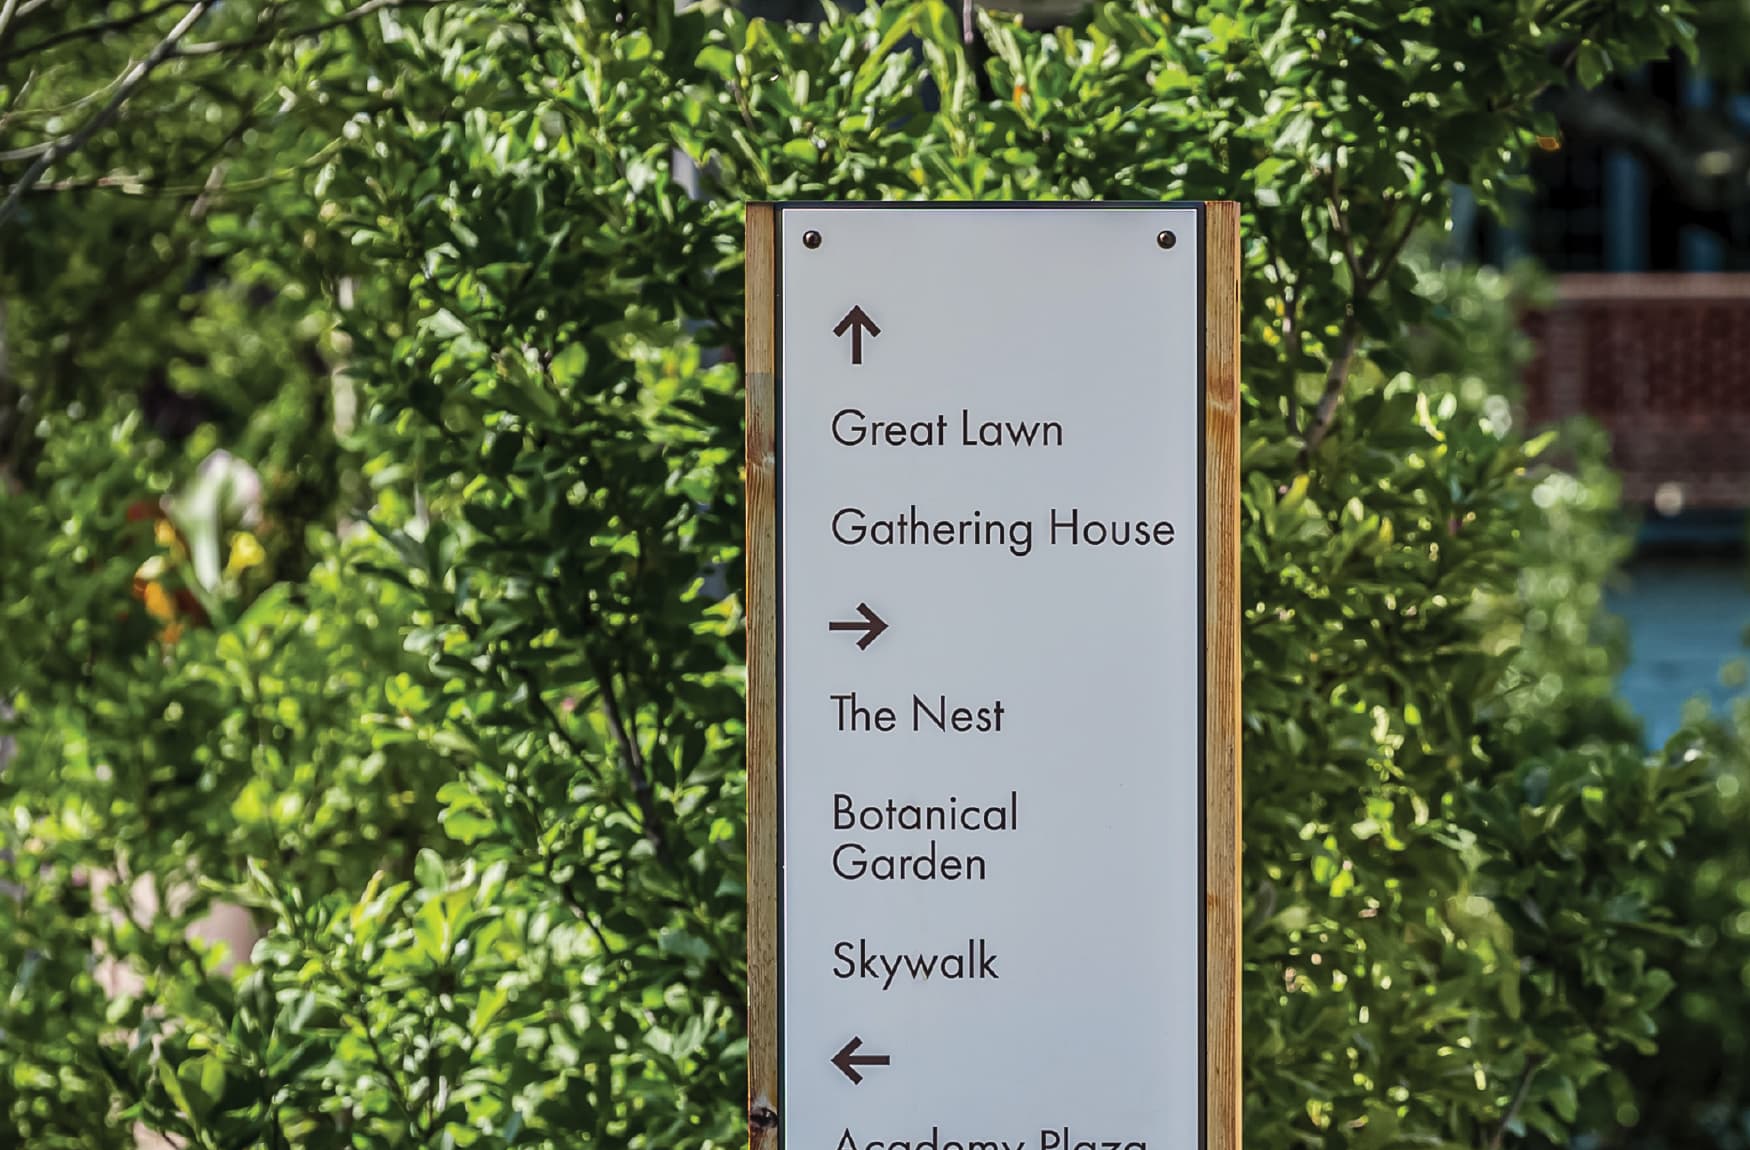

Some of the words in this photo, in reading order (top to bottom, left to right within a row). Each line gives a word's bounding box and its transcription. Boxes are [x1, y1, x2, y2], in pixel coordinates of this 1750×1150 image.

[831, 408, 948, 447] Great
[962, 409, 1063, 447] Lawn
[831, 504, 1032, 557] Gathering
[1051, 508, 1175, 546] House
[829, 691, 897, 732] The
[912, 694, 1005, 733] Nest
[834, 790, 1017, 831] Botanical
[832, 839, 986, 881] Garden
[833, 938, 999, 991] Skywalk
